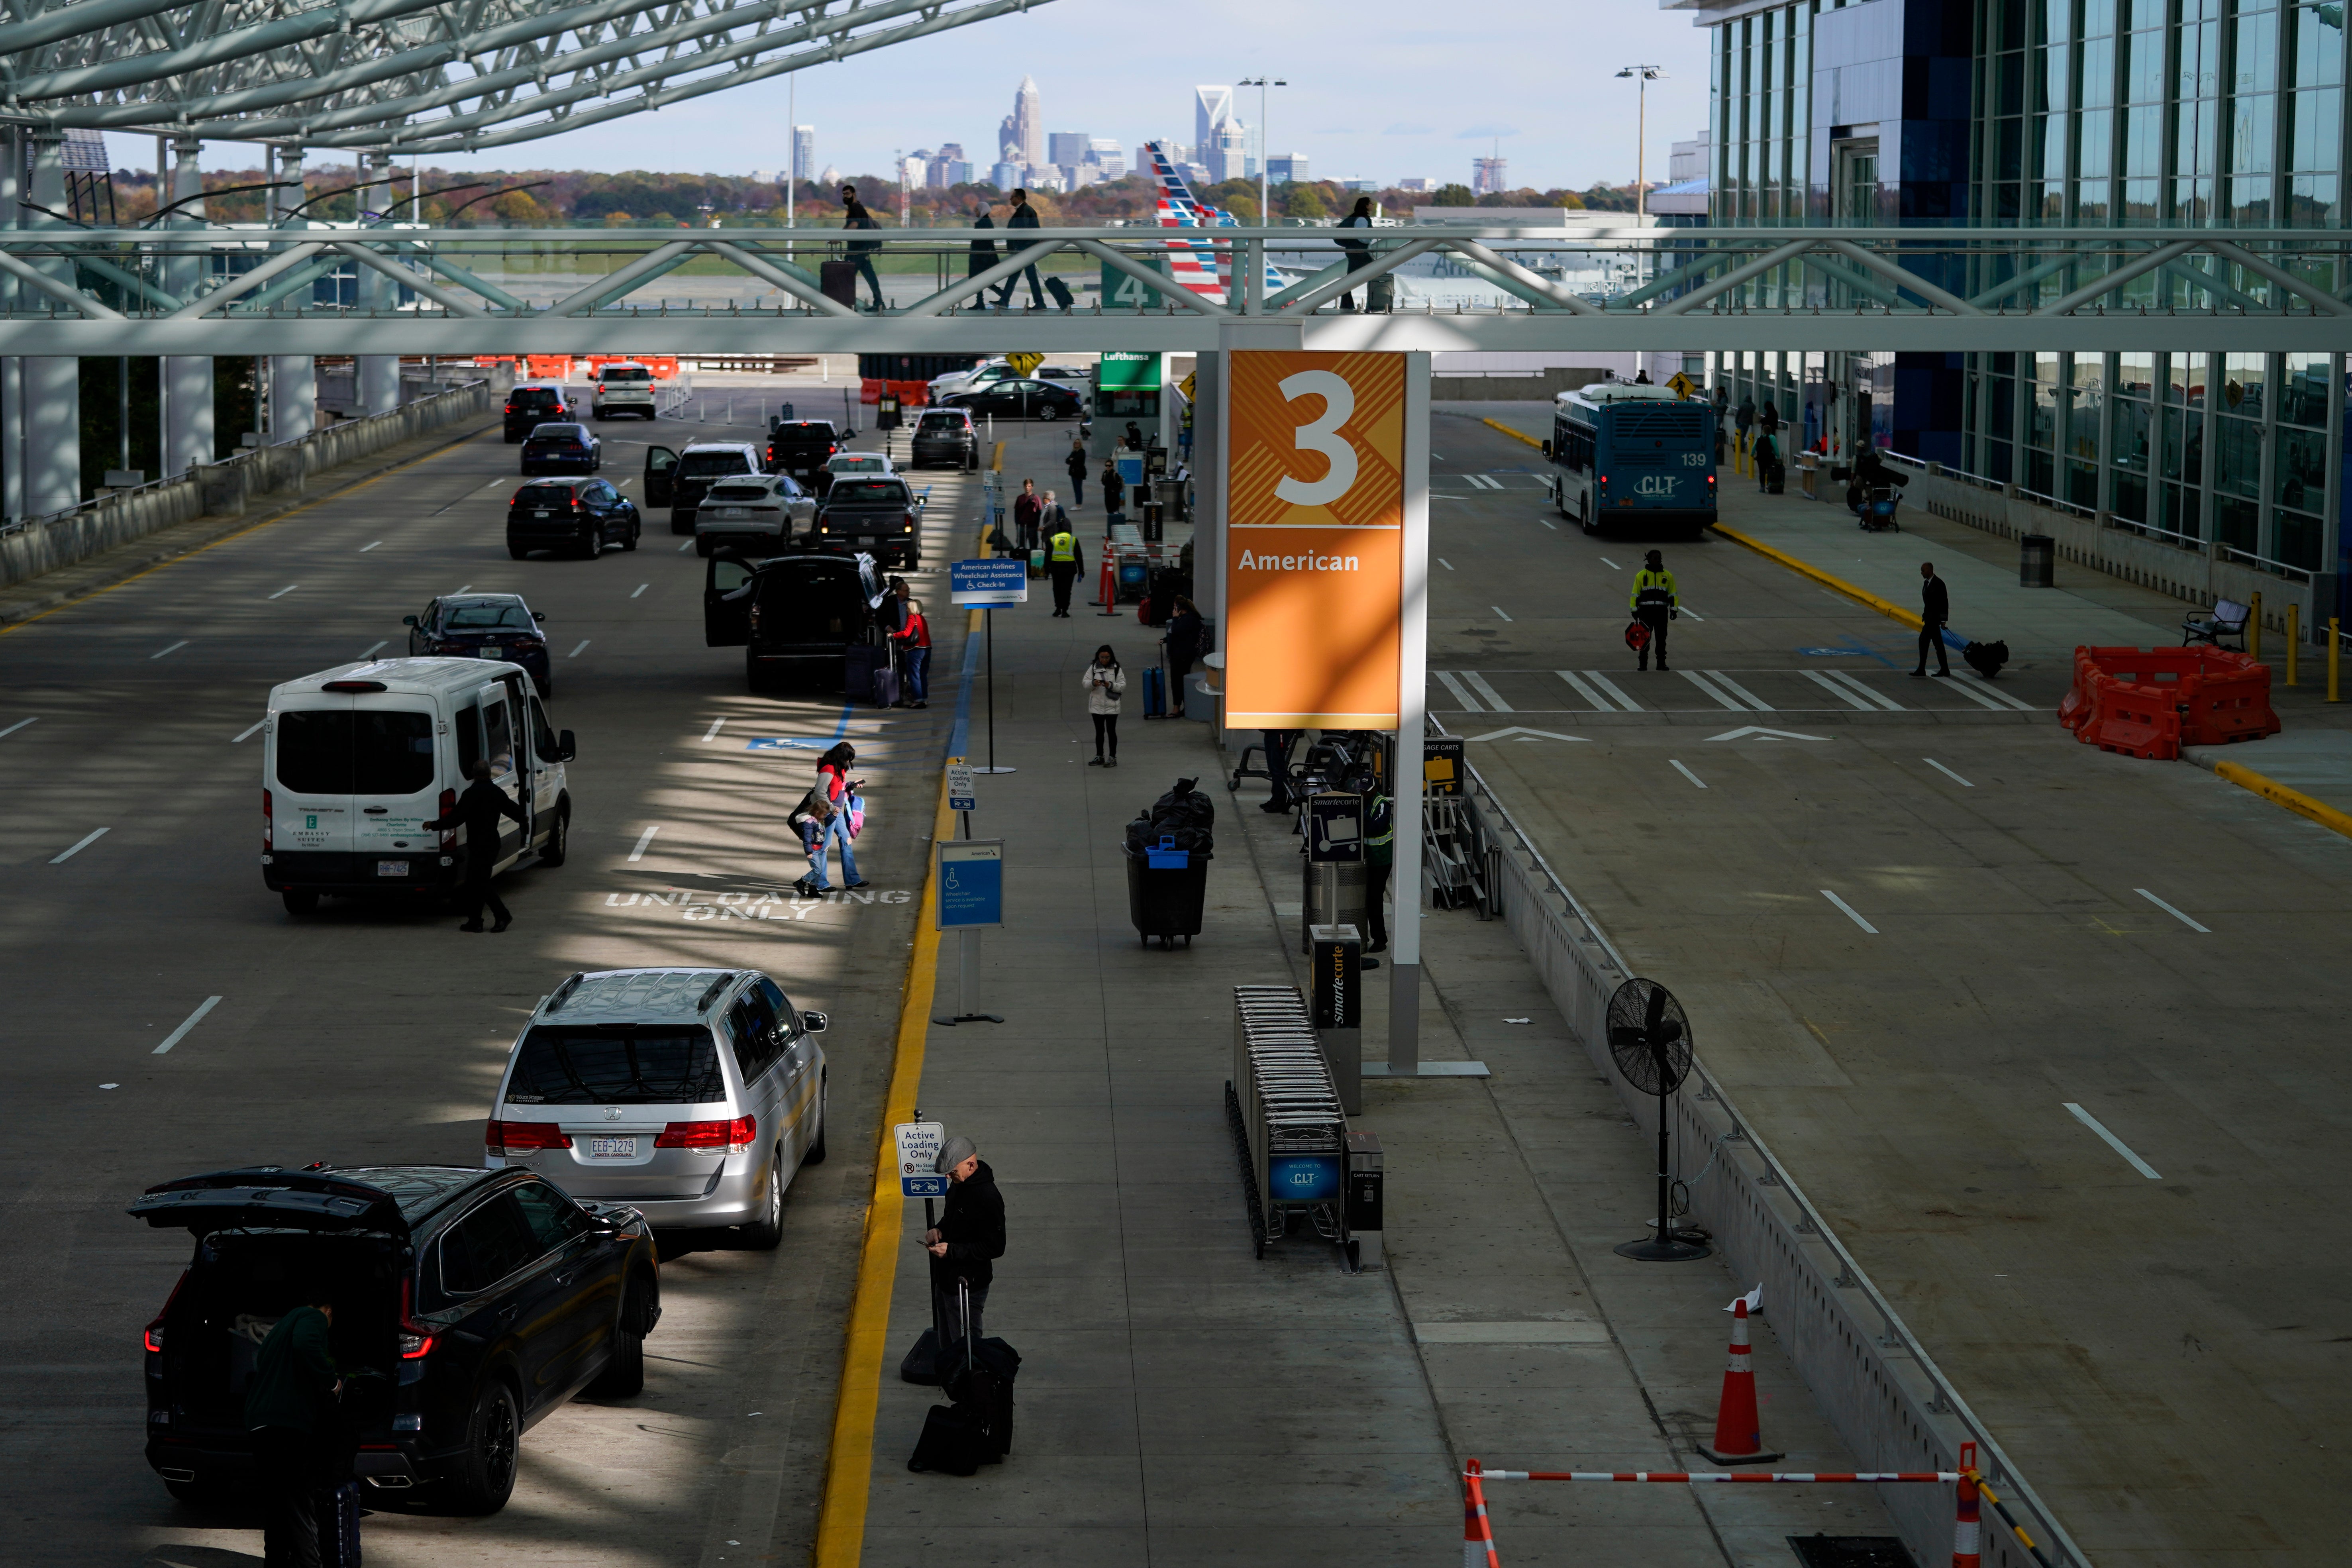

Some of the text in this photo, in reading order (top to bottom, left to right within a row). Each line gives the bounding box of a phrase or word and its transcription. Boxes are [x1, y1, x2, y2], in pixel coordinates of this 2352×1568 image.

[1114, 274, 1149, 303] 4
[1104, 352, 1149, 361] Lufthansa
[1274, 369, 1358, 506] 3
[1681, 453, 1706, 467] 139
[1642, 476, 1676, 494] CLT
[1238, 549, 1358, 571] American
[604, 891, 911, 907] UNLOADING
[682, 905, 819, 920] ONLY
[1332, 945, 1343, 1024] smartecarte
[905, 1131, 934, 1139] Active
[592, 1141, 634, 1152] EEB-1279
[902, 1140, 939, 1150] Loading
[910, 1150, 932, 1160] Only
[1295, 1173, 1314, 1183] CLT
